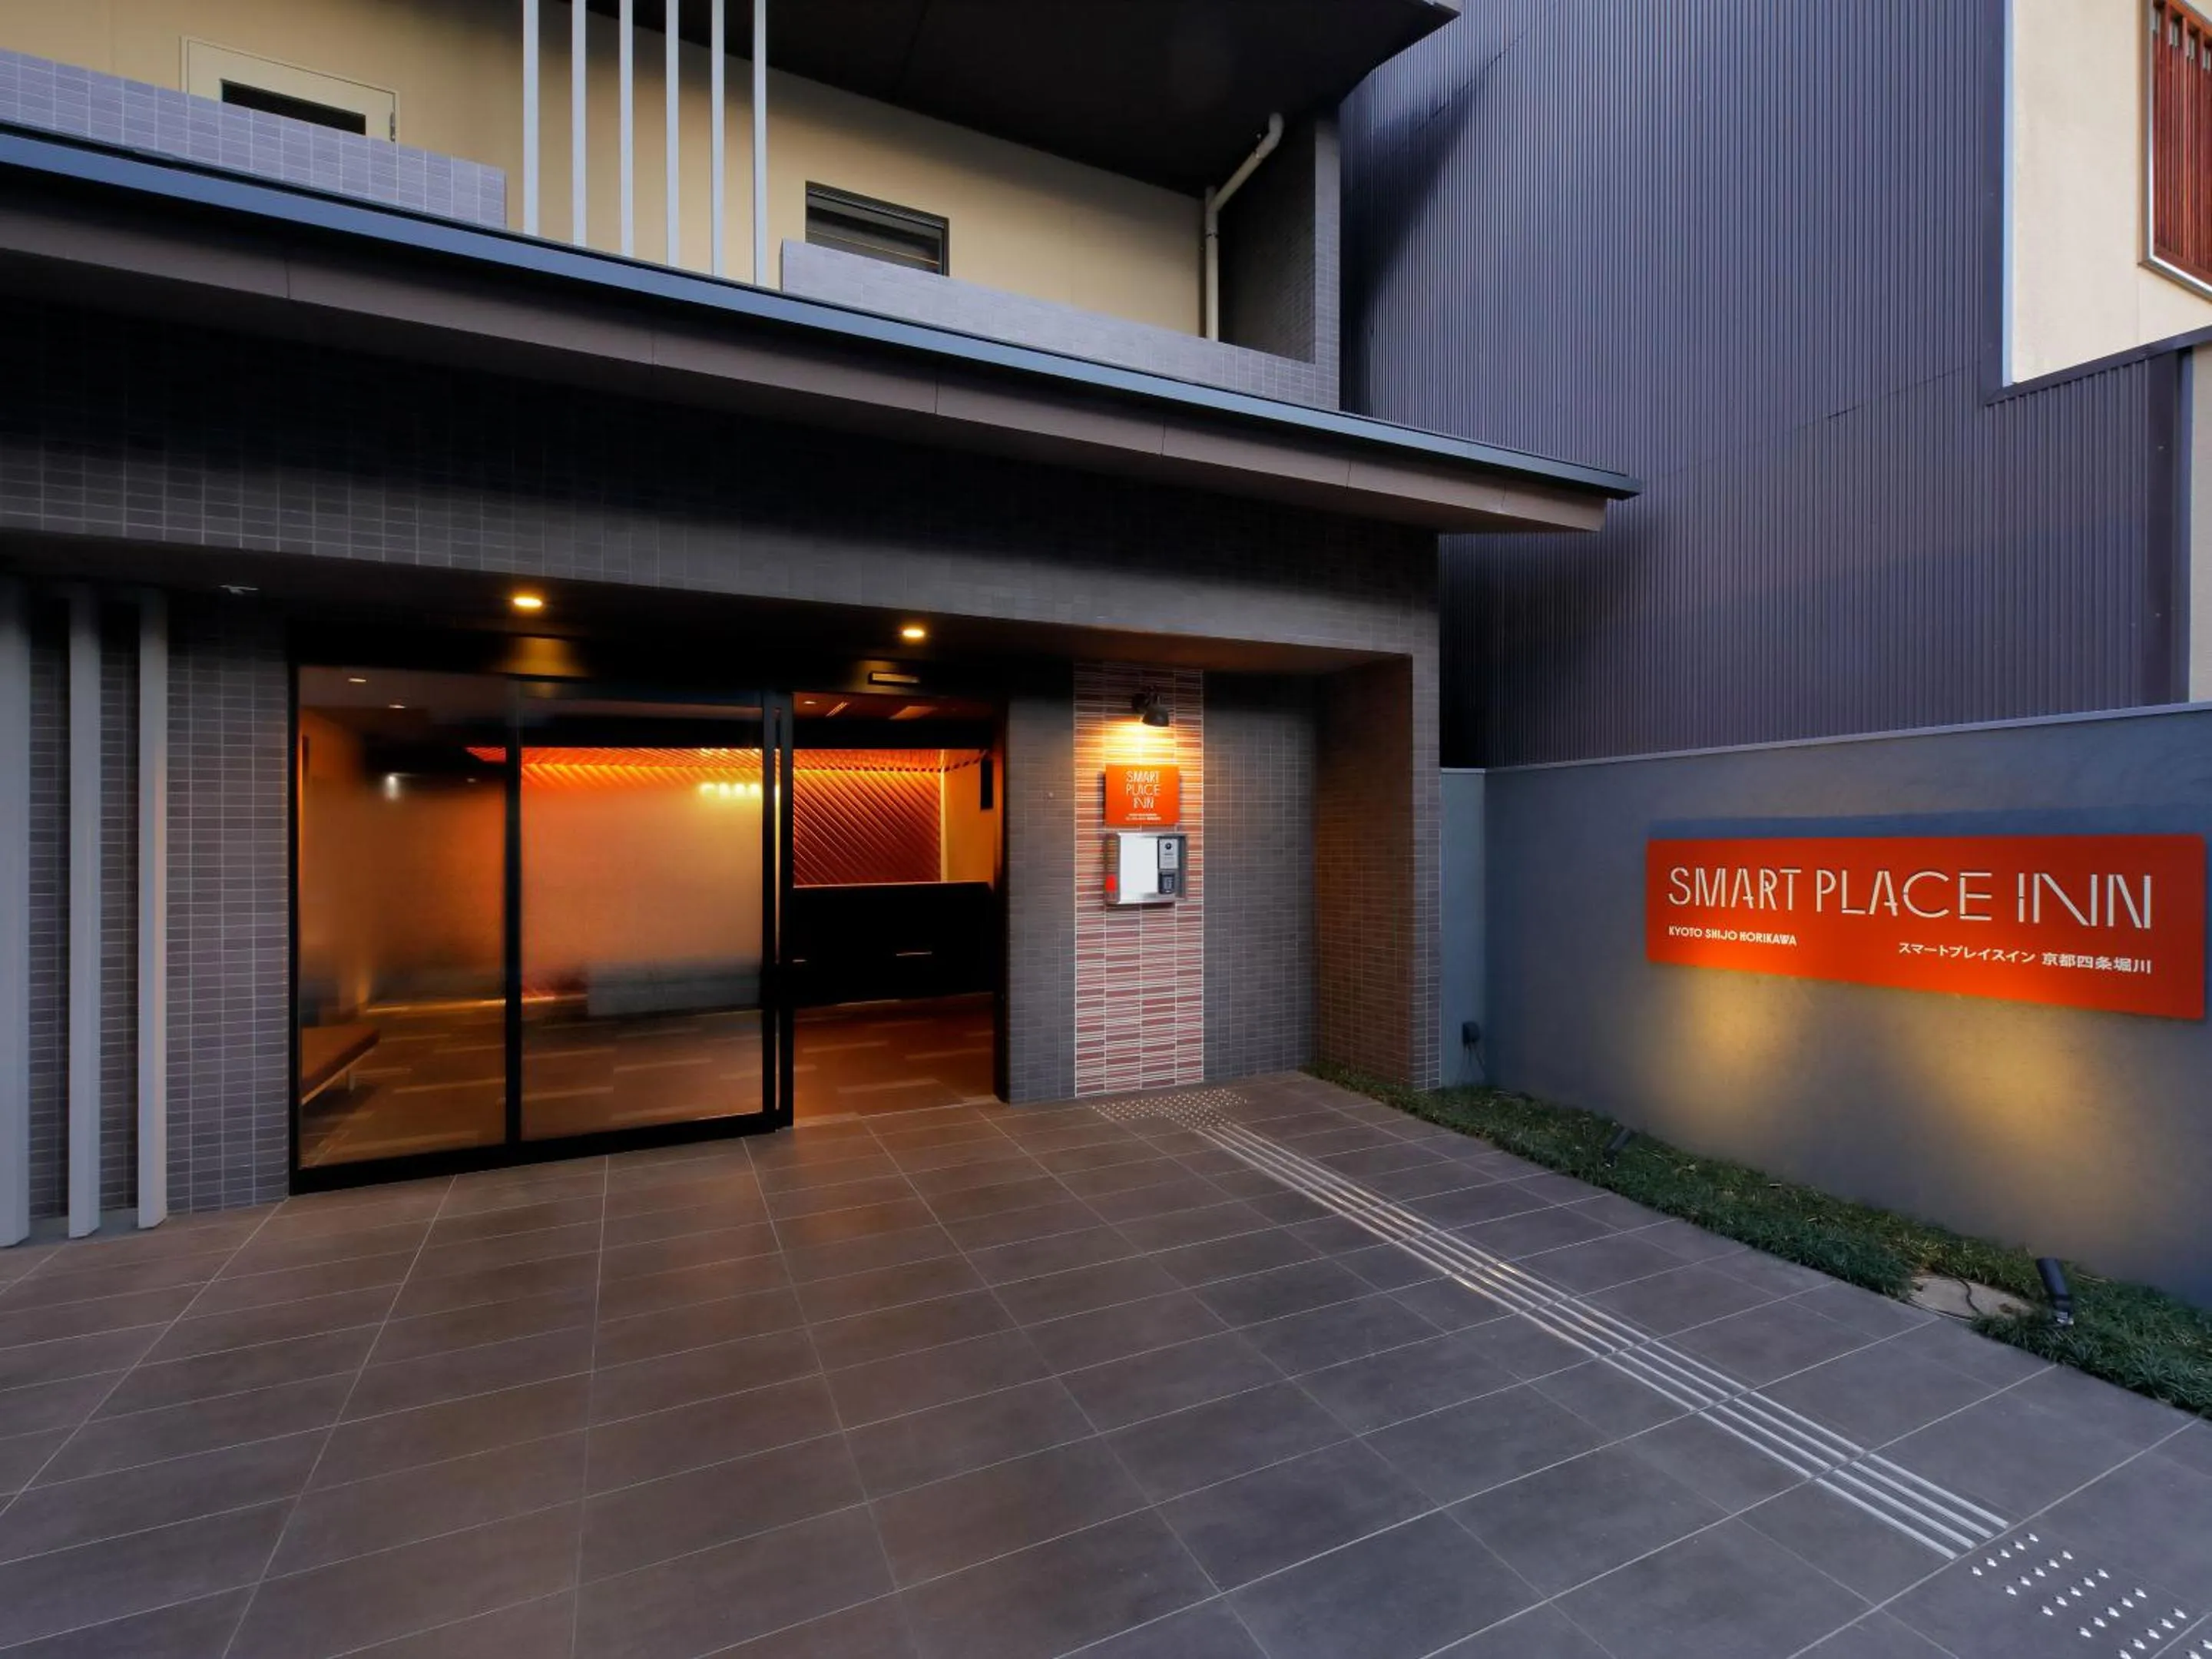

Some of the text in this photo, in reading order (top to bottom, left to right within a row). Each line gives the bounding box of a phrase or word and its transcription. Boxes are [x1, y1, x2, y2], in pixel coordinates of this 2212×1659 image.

[1125, 770, 1160, 783] SMART
[1126, 783, 1161, 796] PLACE
[1133, 796, 1154, 808] INN
[1668, 867, 2151, 929] SMART PLACE INN
[1668, 926, 1797, 946] KYOTO SHIJO HORIKAWA
[1898, 942, 2151, 974] スマートプレイスイン 京都四条堀川
